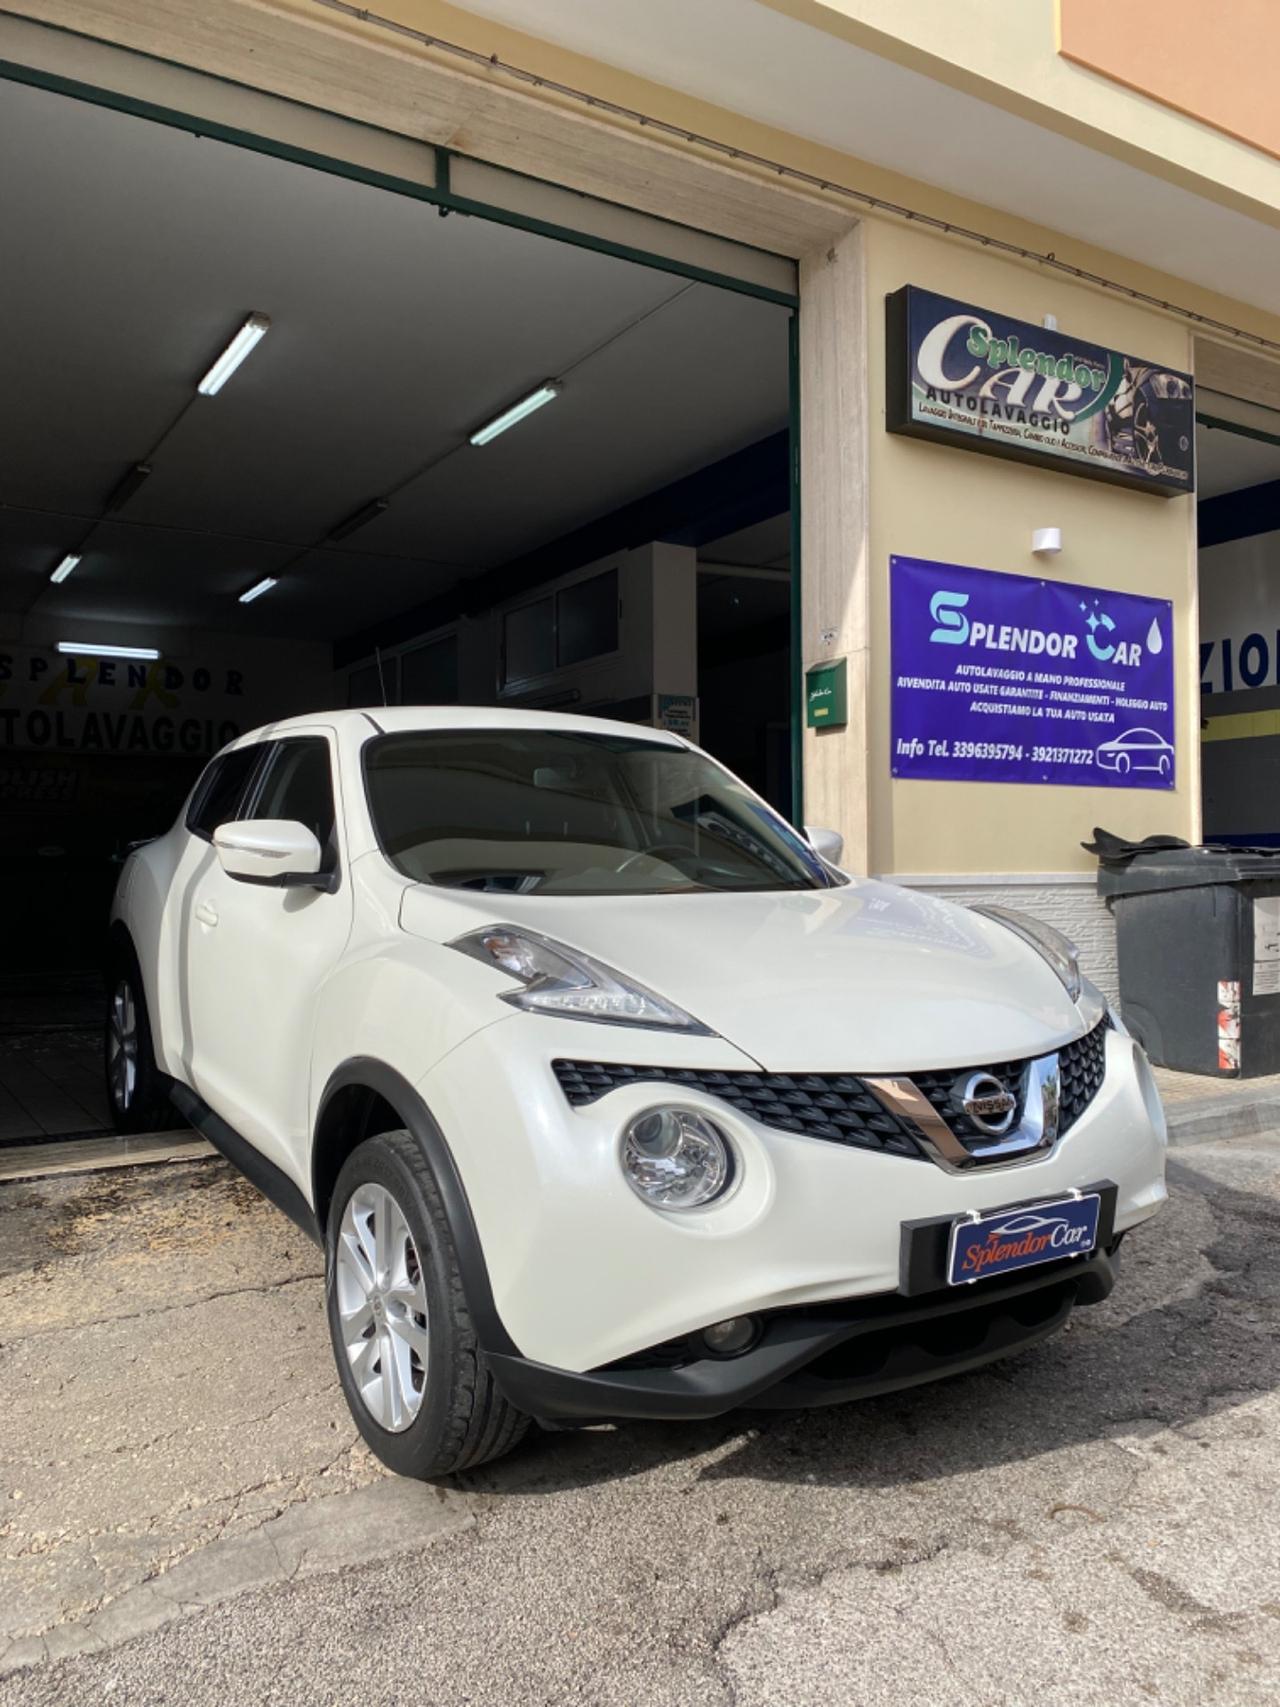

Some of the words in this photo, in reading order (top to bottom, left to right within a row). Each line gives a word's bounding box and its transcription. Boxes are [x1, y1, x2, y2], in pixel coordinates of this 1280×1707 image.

[966, 325, 1106, 391] Splendor
[926, 386, 1070, 435] AUTOLAVAGGIO
[929, 590, 1078, 659] SPLENDOR
[1085, 612, 1142, 667] CAR
[955, 664, 1025, 682] AUTOLAVAGGIO
[1026, 672, 1033, 682] A
[1034, 672, 1062, 686] MANO
[1063, 675, 1125, 692] PROFESSIONALE
[1200, 629, 1280, 693] ZIO
[897, 676, 946, 691] RIVENDITA
[947, 681, 972, 693] AUTO
[973, 683, 999, 695] USATE
[999, 688, 1043, 700] GARANTITE
[1049, 690, 1110, 706] FINANZIAMENTI
[1115, 697, 1149, 710] NOLEGGIO
[1149, 701, 1168, 712] AUTO
[970, 701, 1031, 716] ACQUISTIAMO
[1032, 707, 1043, 718] LA
[1045, 708, 1063, 719] TUA
[1064, 710, 1086, 721] AUTO
[1088, 711, 1115, 723] USATA
[897, 738, 924, 758] Info
[928, 740, 950, 757] Tel.
[952, 741, 1023, 761] 3396395794
[1031, 746, 1094, 765] 3921371272
